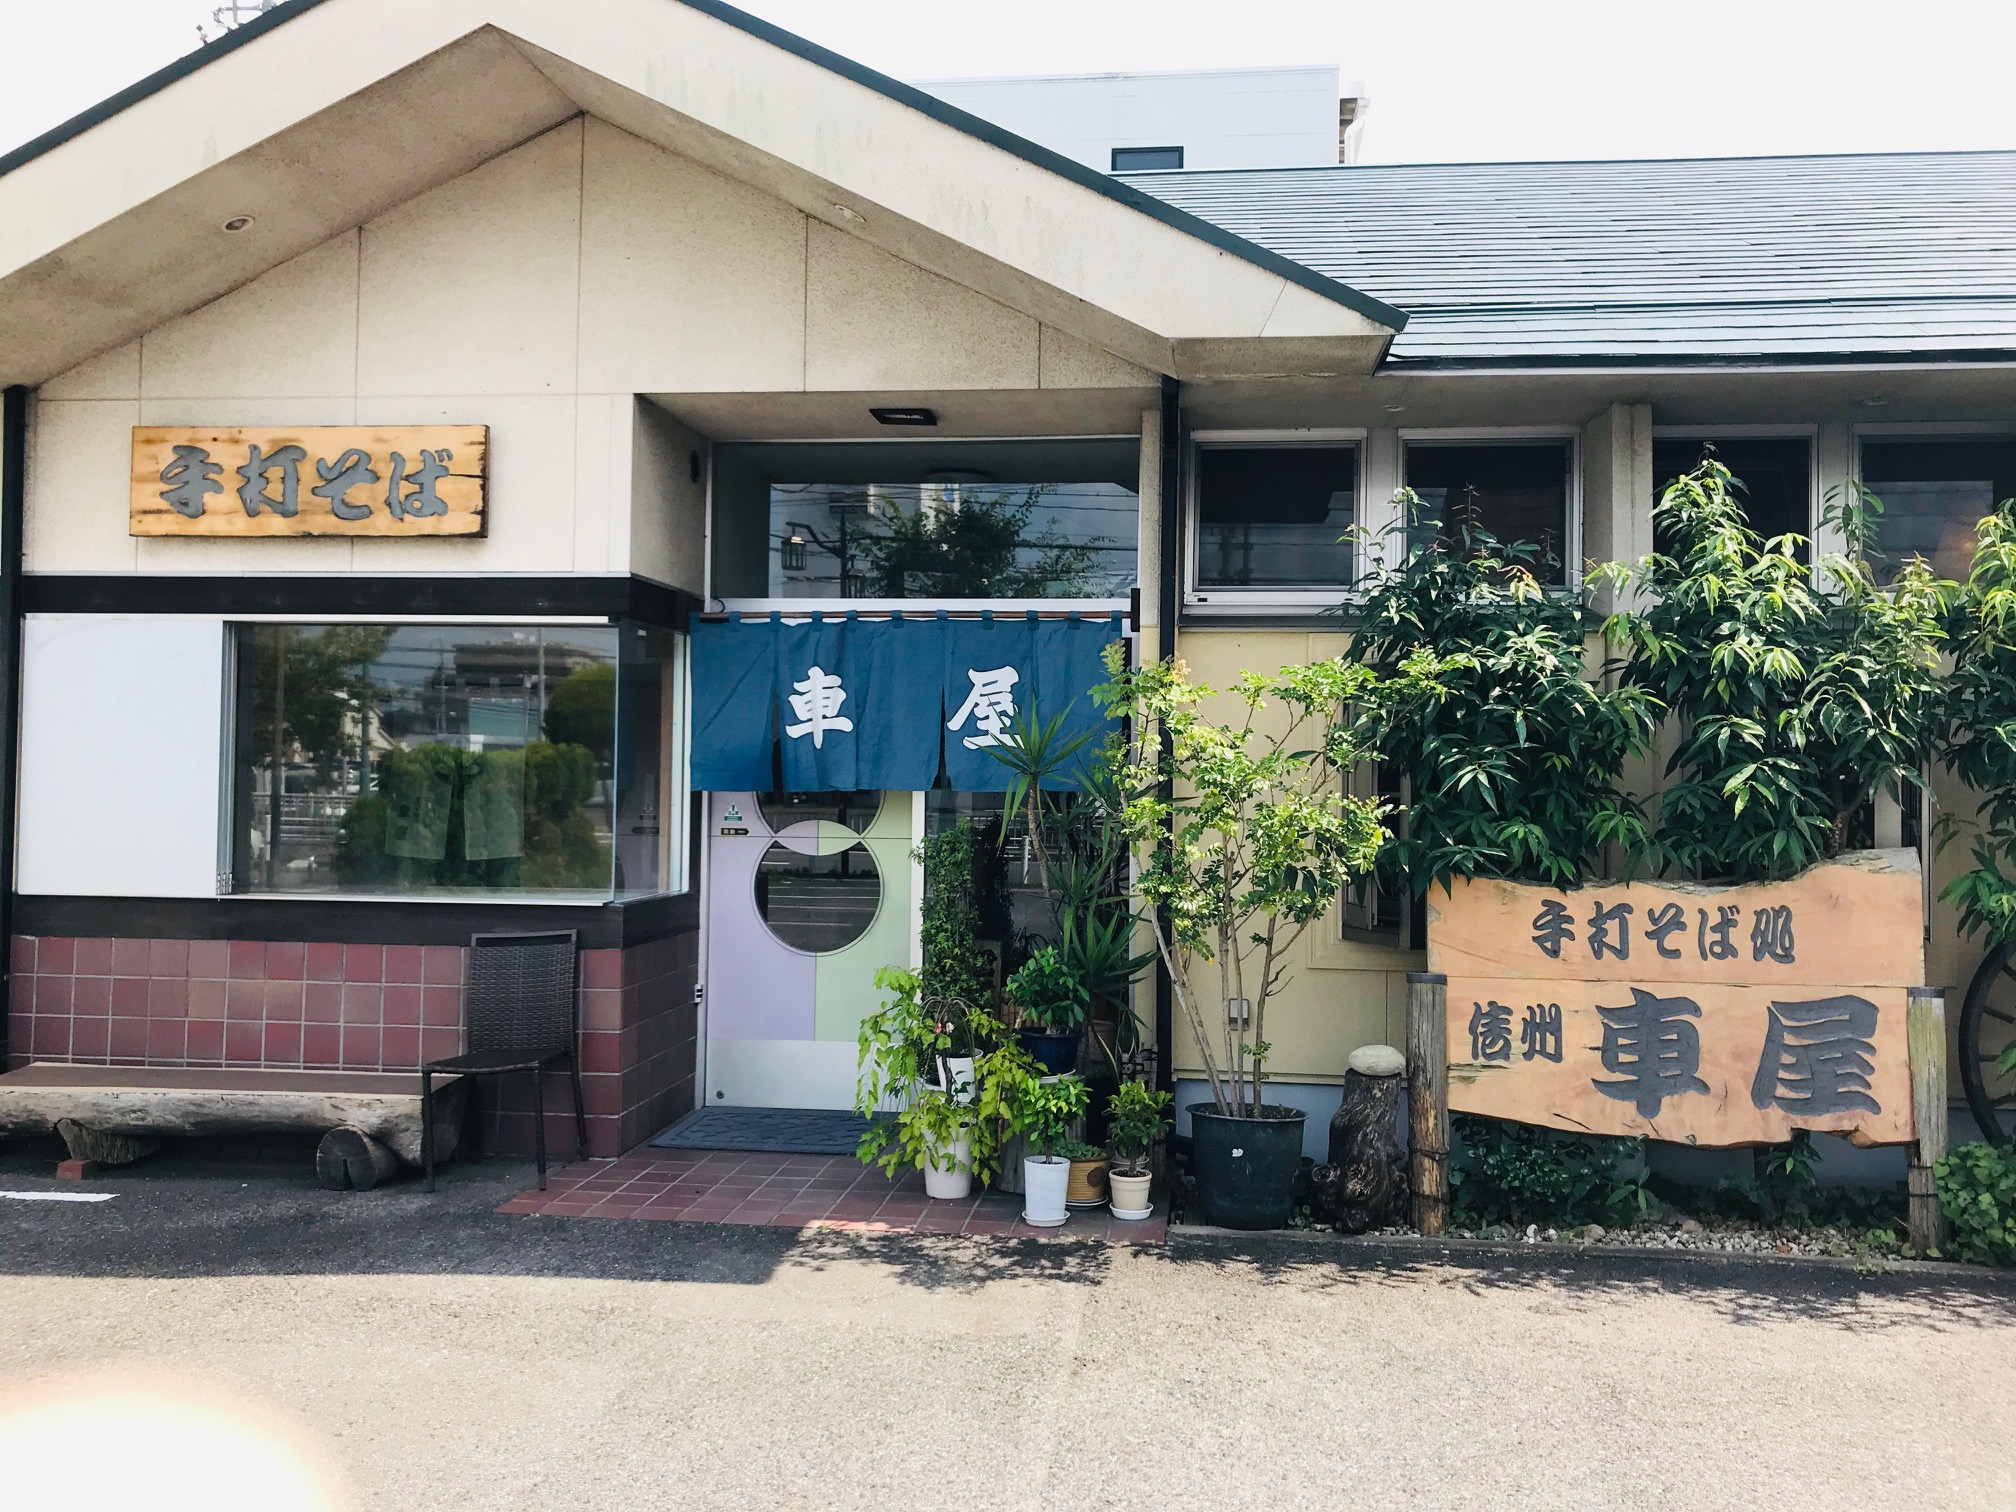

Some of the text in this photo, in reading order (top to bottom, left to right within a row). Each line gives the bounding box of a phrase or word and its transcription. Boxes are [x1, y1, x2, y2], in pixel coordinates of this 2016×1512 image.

[160, 444, 453, 520] 手打そば
[785, 665, 1026, 750] 車屋
[1531, 899, 1796, 964] 手打そば処
[1468, 987, 1882, 1119] 信州 車屋
